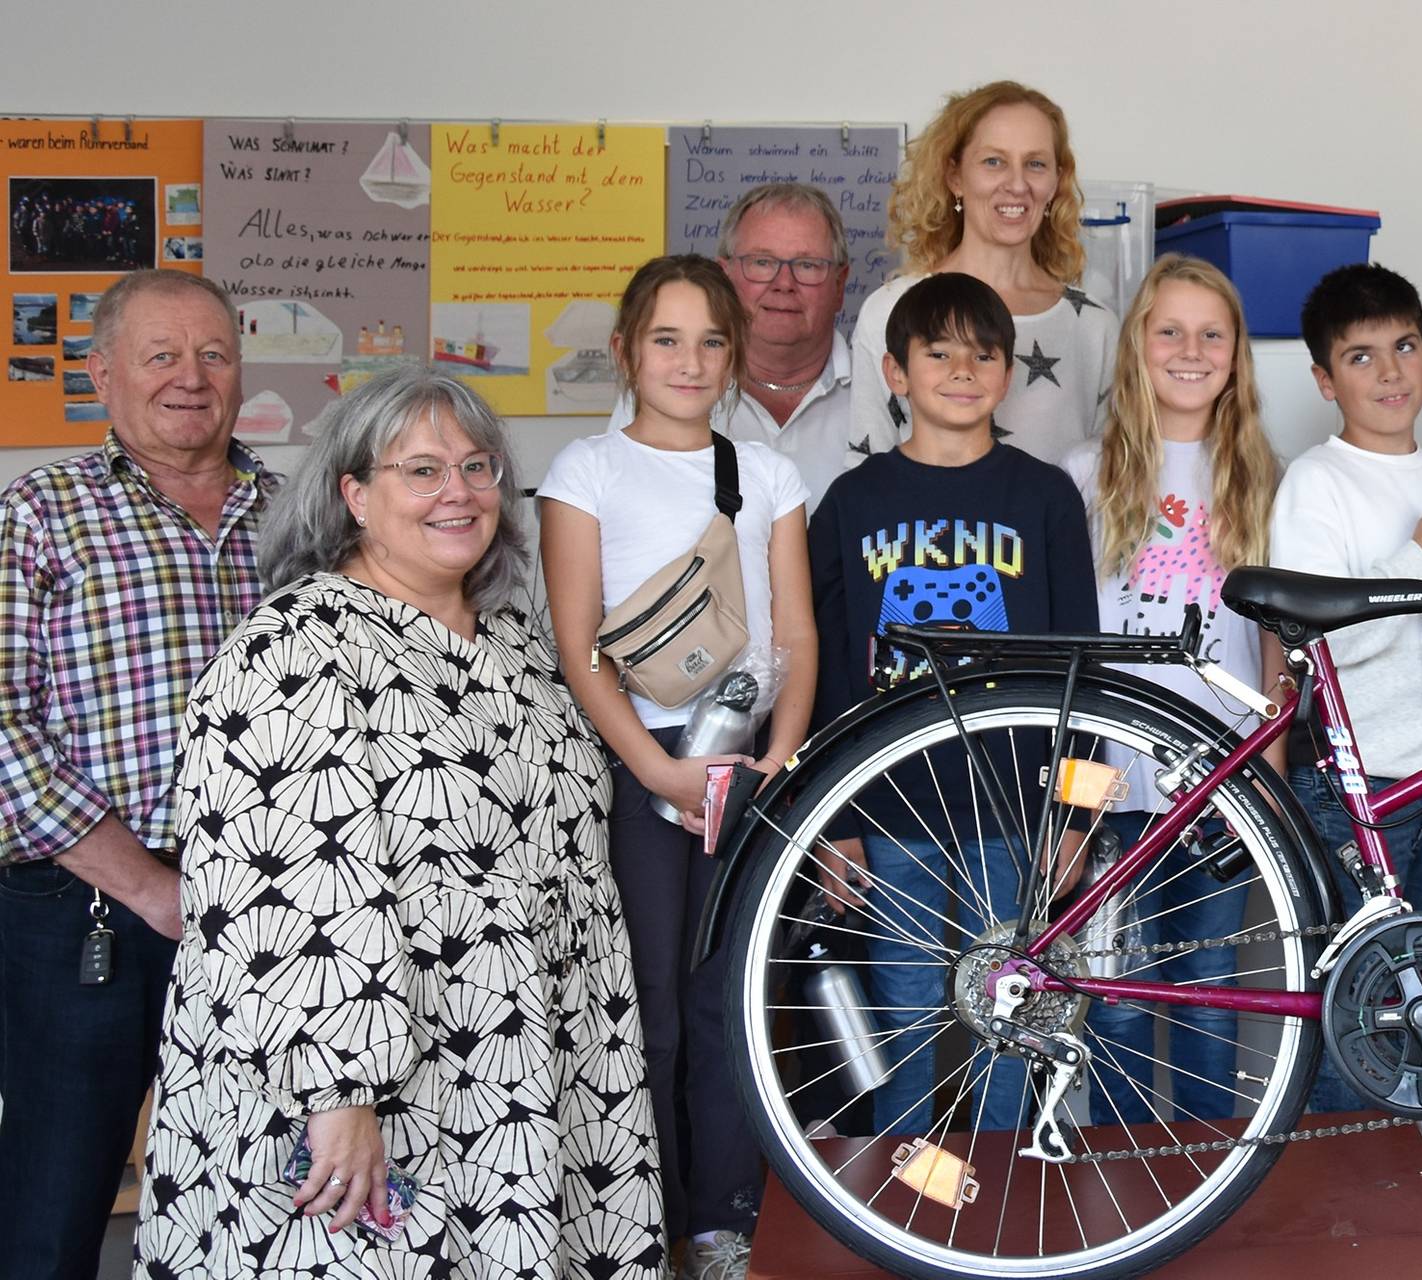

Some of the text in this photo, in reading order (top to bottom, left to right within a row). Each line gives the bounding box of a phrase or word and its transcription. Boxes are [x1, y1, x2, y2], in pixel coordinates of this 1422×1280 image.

[8, 135, 44, 149] waren
[48, 131, 75, 149] beim
[228, 135, 260, 151] WAS
[446, 129, 606, 157] Was macht der
[683, 134, 733, 155] Warum
[749, 143, 800, 157] schwimmt
[809, 143, 828, 157] ein
[220, 160, 253, 180] WAS
[264, 167, 300, 182] SINKT
[450, 161, 644, 190] Gegenstand mit dem
[686, 157, 725, 183] Das
[504, 187, 593, 214] Wasser?
[840, 189, 881, 212] Platz
[431, 231, 450, 243] Der
[684, 218, 721, 239] und
[239, 253, 274, 270] als
[281, 254, 309, 270] die
[315, 252, 385, 273] gleiche
[223, 279, 283, 297] Wasser
[861, 519, 1024, 583] WKND
[1130, 719, 1189, 751] SCHWALBE
[1237, 792, 1265, 825] CRUISER
[1262, 825, 1280, 849] PLUS
